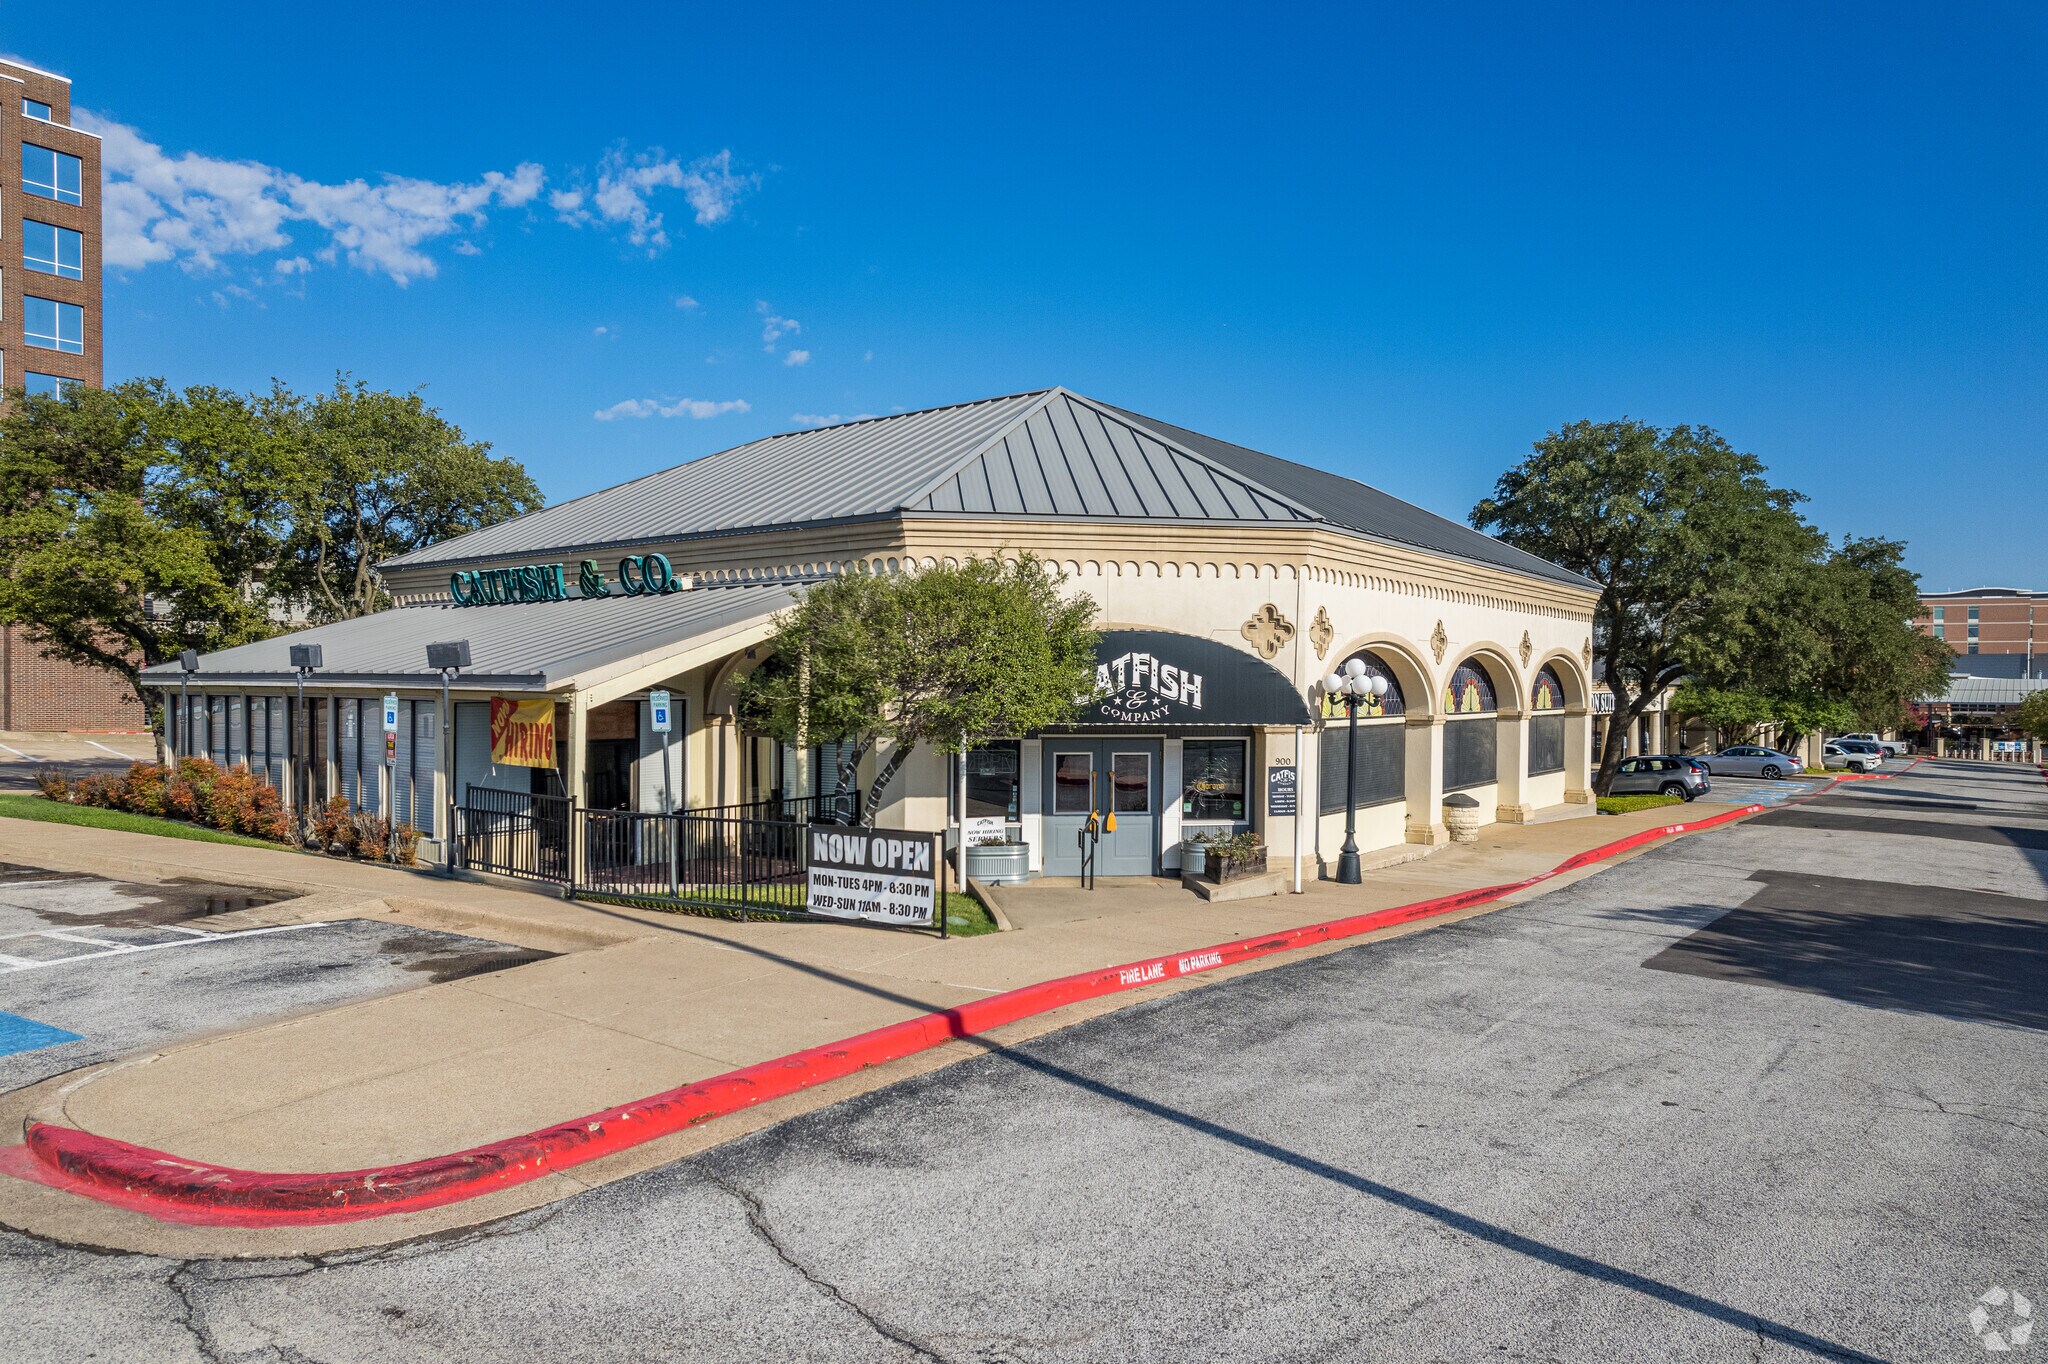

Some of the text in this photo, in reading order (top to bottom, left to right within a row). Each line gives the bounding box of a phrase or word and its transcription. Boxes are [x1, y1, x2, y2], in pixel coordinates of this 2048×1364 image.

[450, 552, 683, 607] CATFISH & CO.
[1073, 652, 1202, 710] ATFISH
[1126, 689, 1148, 709] &
[491, 700, 510, 738] NOW
[1101, 704, 1170, 722] COMPANY
[504, 722, 553, 761] HIRING
[1275, 757, 1291, 766] 900
[1270, 769, 1296, 783] CATFIS
[813, 832, 930, 872] NOW OPEN
[813, 873, 861, 891] MON-TUES
[862, 879, 883, 893] 4PM
[888, 882, 913, 896] 8:30
[914, 884, 930, 898] PM
[812, 894, 856, 910] WED-SUN
[858, 899, 881, 913] 11AM
[889, 903, 911, 918] 8:30
[912, 904, 928, 920] PM
[1120, 962, 1165, 985] FIRE LANE
[1178, 951, 1222, 974] NO PARKING
